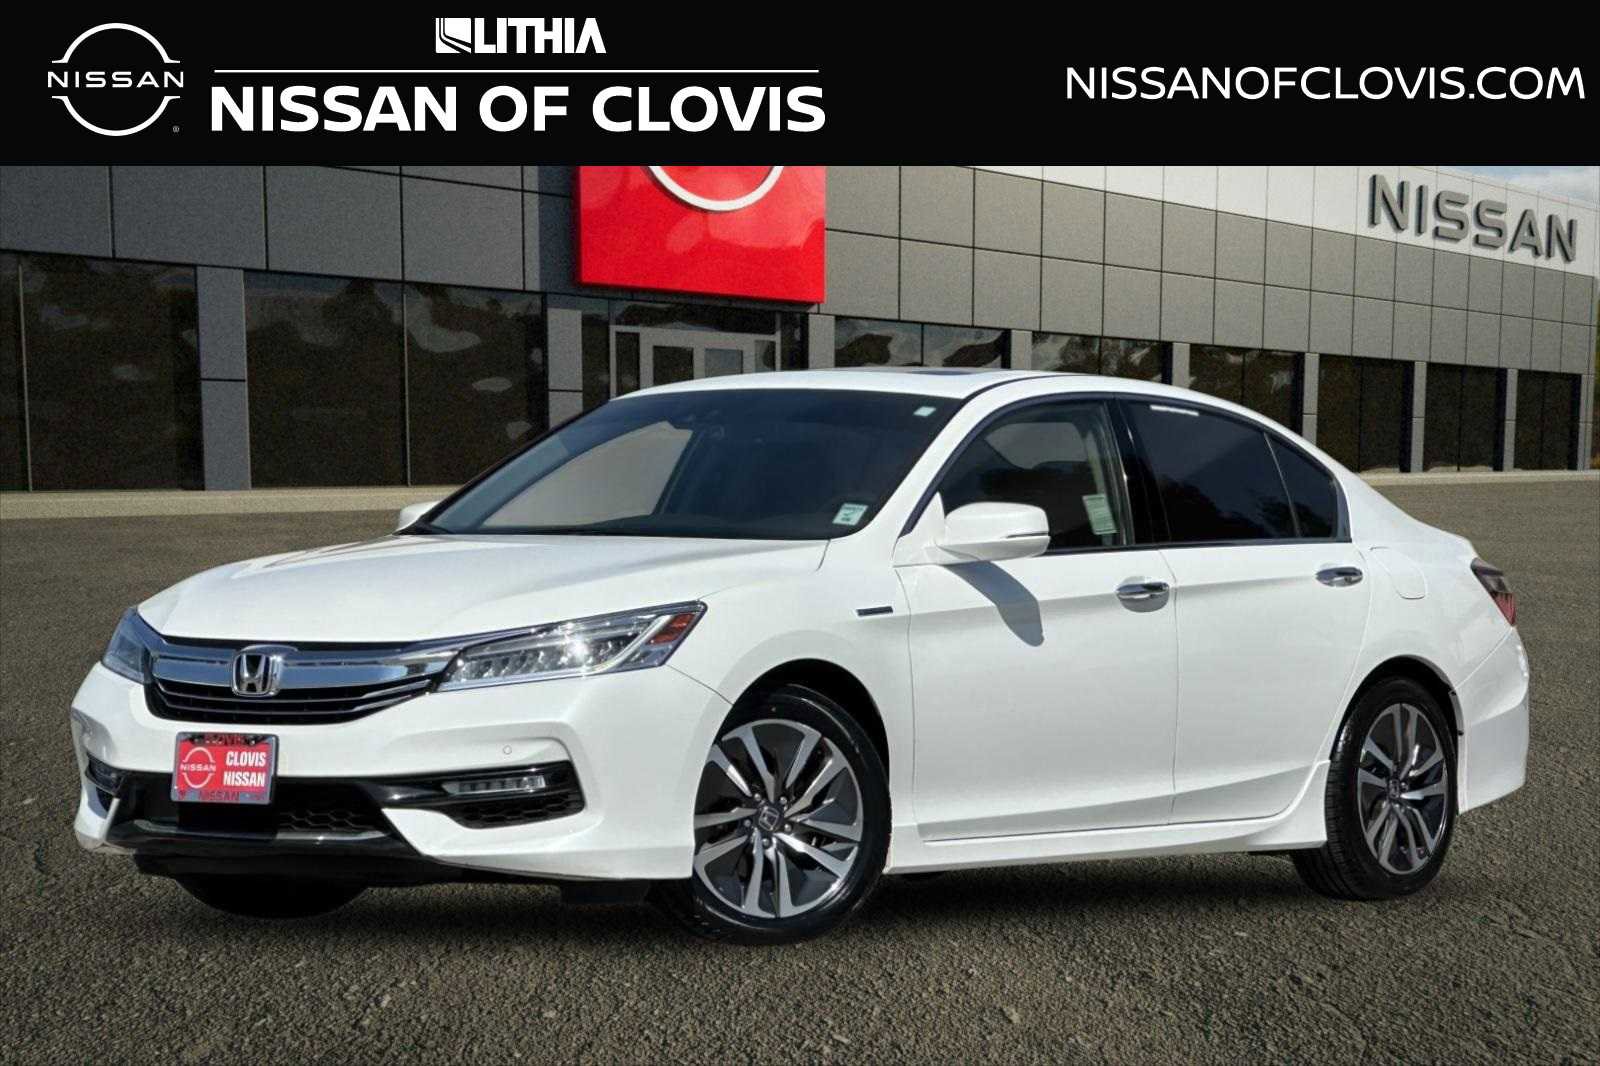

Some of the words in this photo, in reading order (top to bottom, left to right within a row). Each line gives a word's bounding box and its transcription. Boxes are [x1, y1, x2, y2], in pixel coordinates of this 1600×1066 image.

[1368, 174, 1577, 262] NISSAN
[226, 751, 267, 767] CLOVIS
[180, 763, 217, 772] NISSAN
[222, 771, 266, 787] NISSAN
